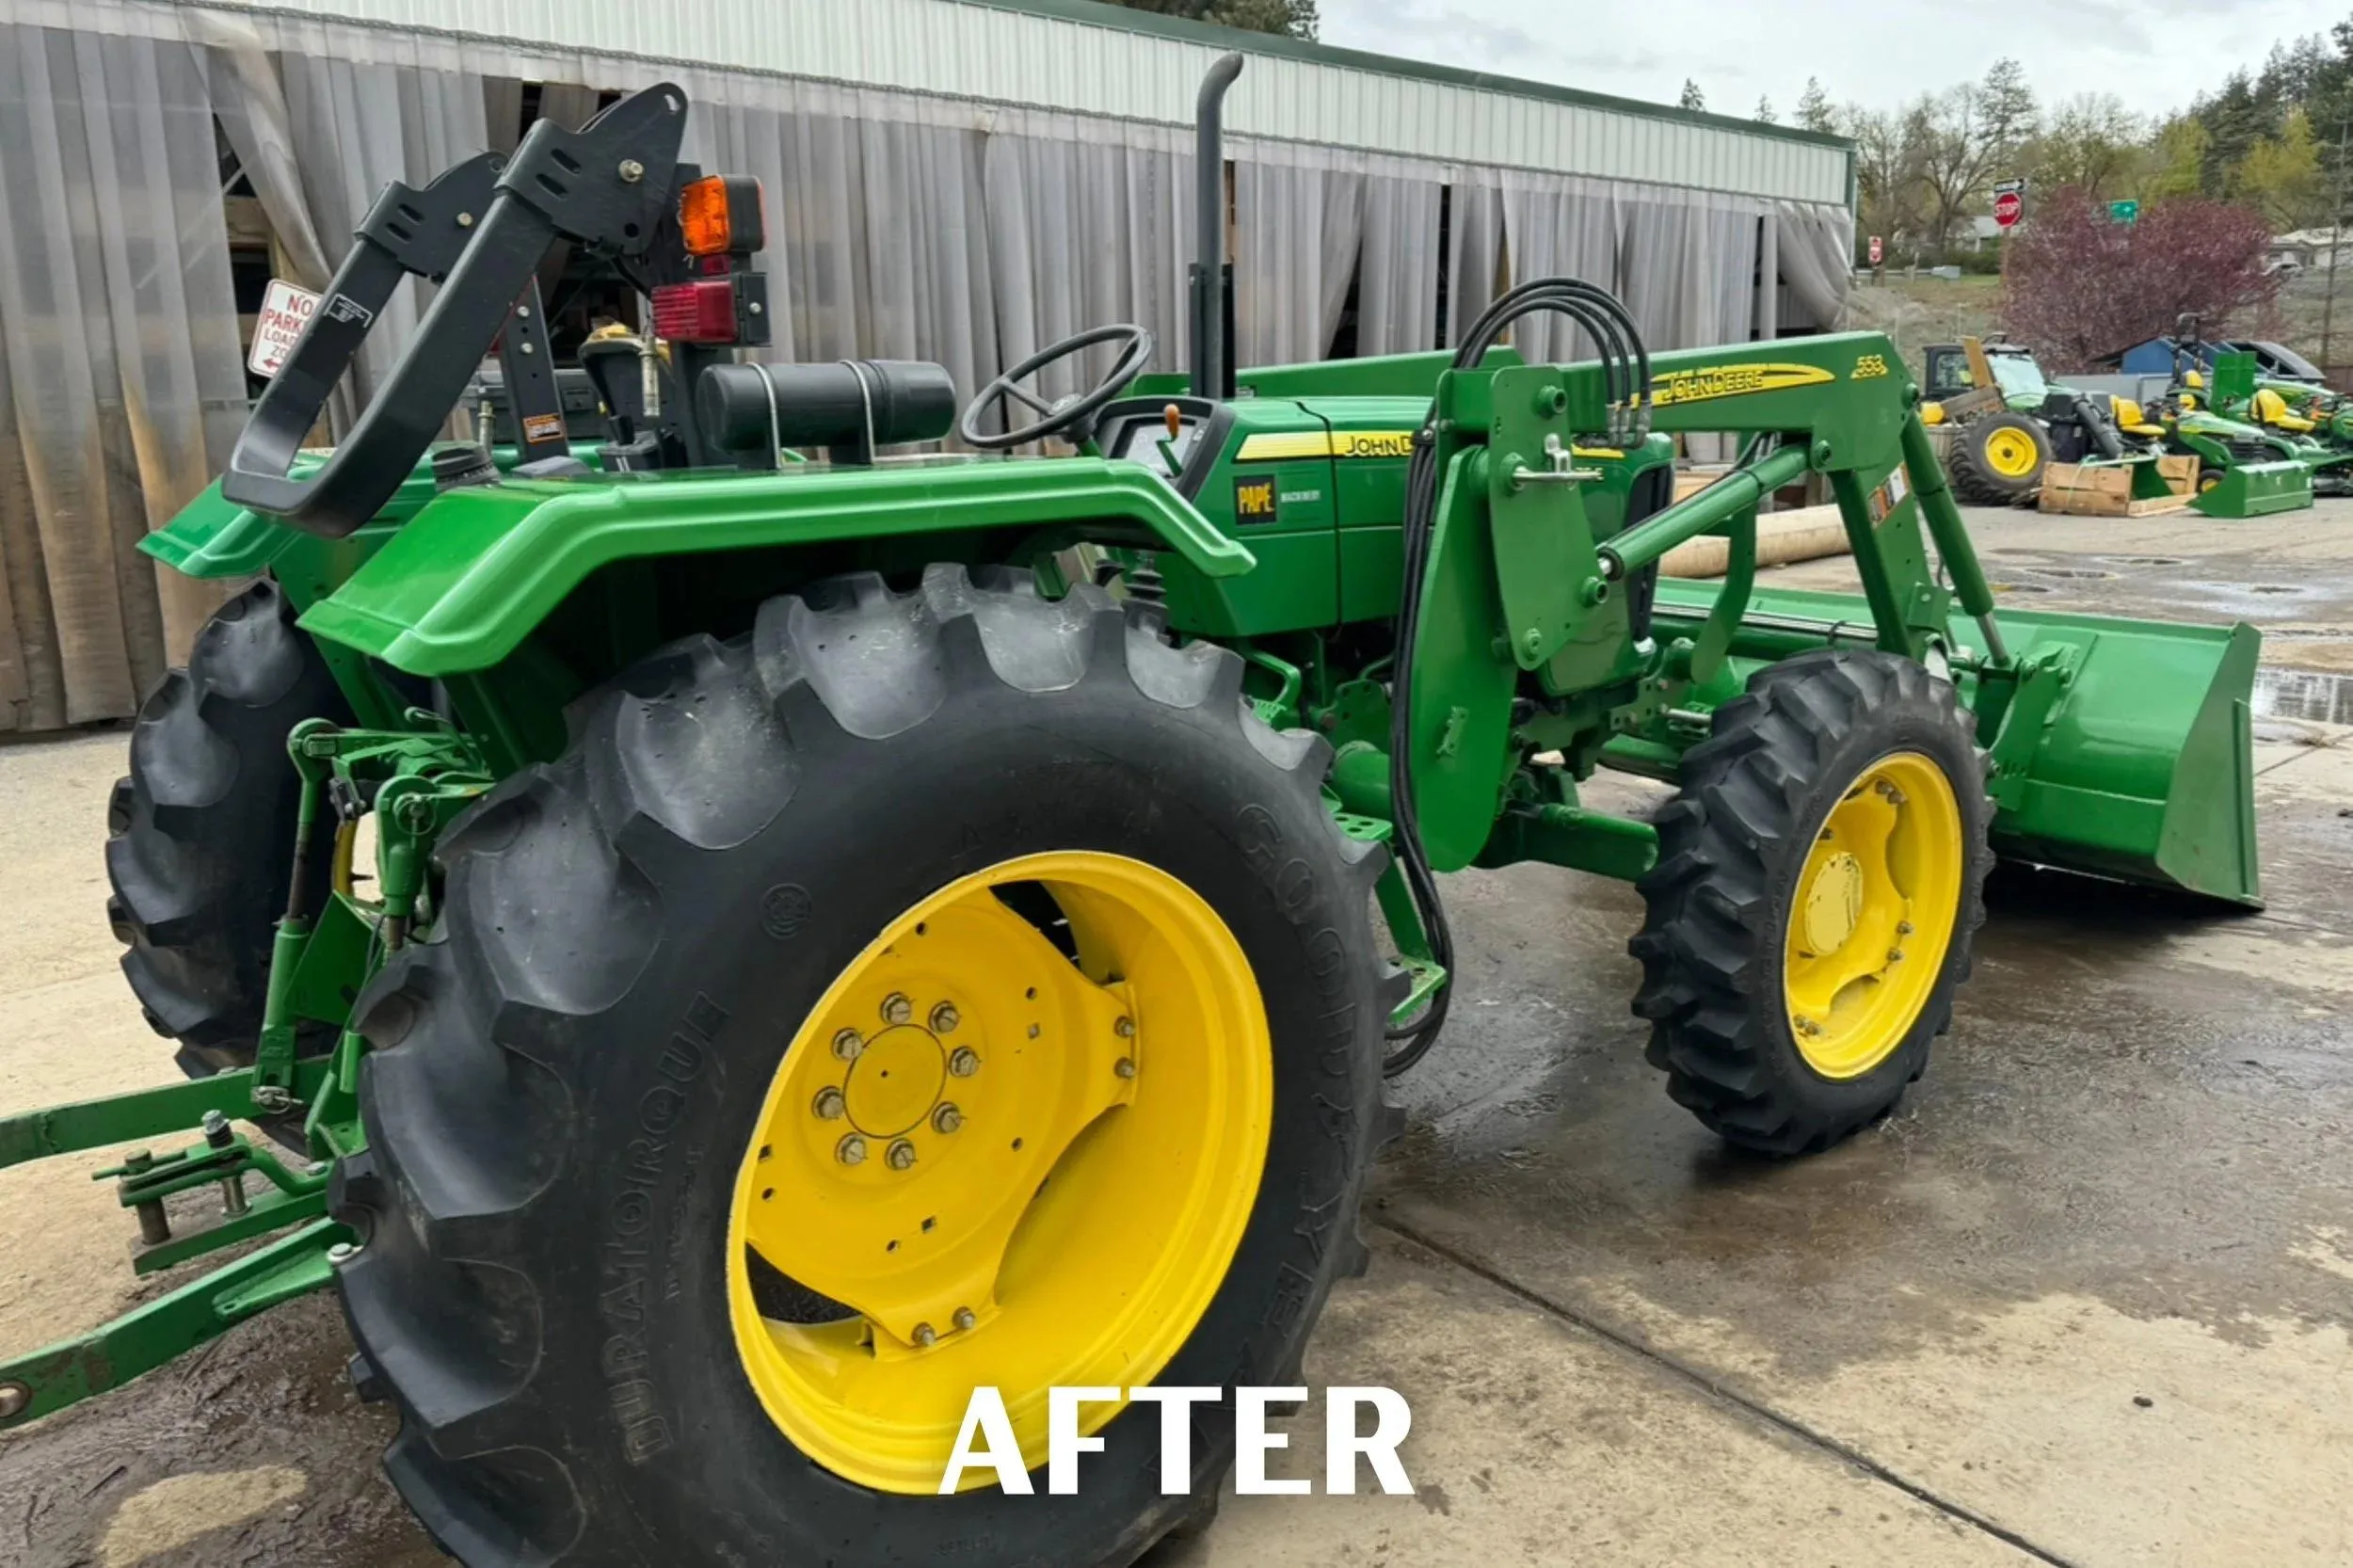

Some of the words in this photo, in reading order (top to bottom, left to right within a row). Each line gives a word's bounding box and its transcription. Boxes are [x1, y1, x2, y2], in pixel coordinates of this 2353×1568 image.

[286, 294, 313, 317] NO
[262, 308, 303, 332] PARK
[1661, 375, 1712, 402] JOHN
[1712, 370, 1765, 394] DEERE
[1345, 435, 1399, 454] JOHN
